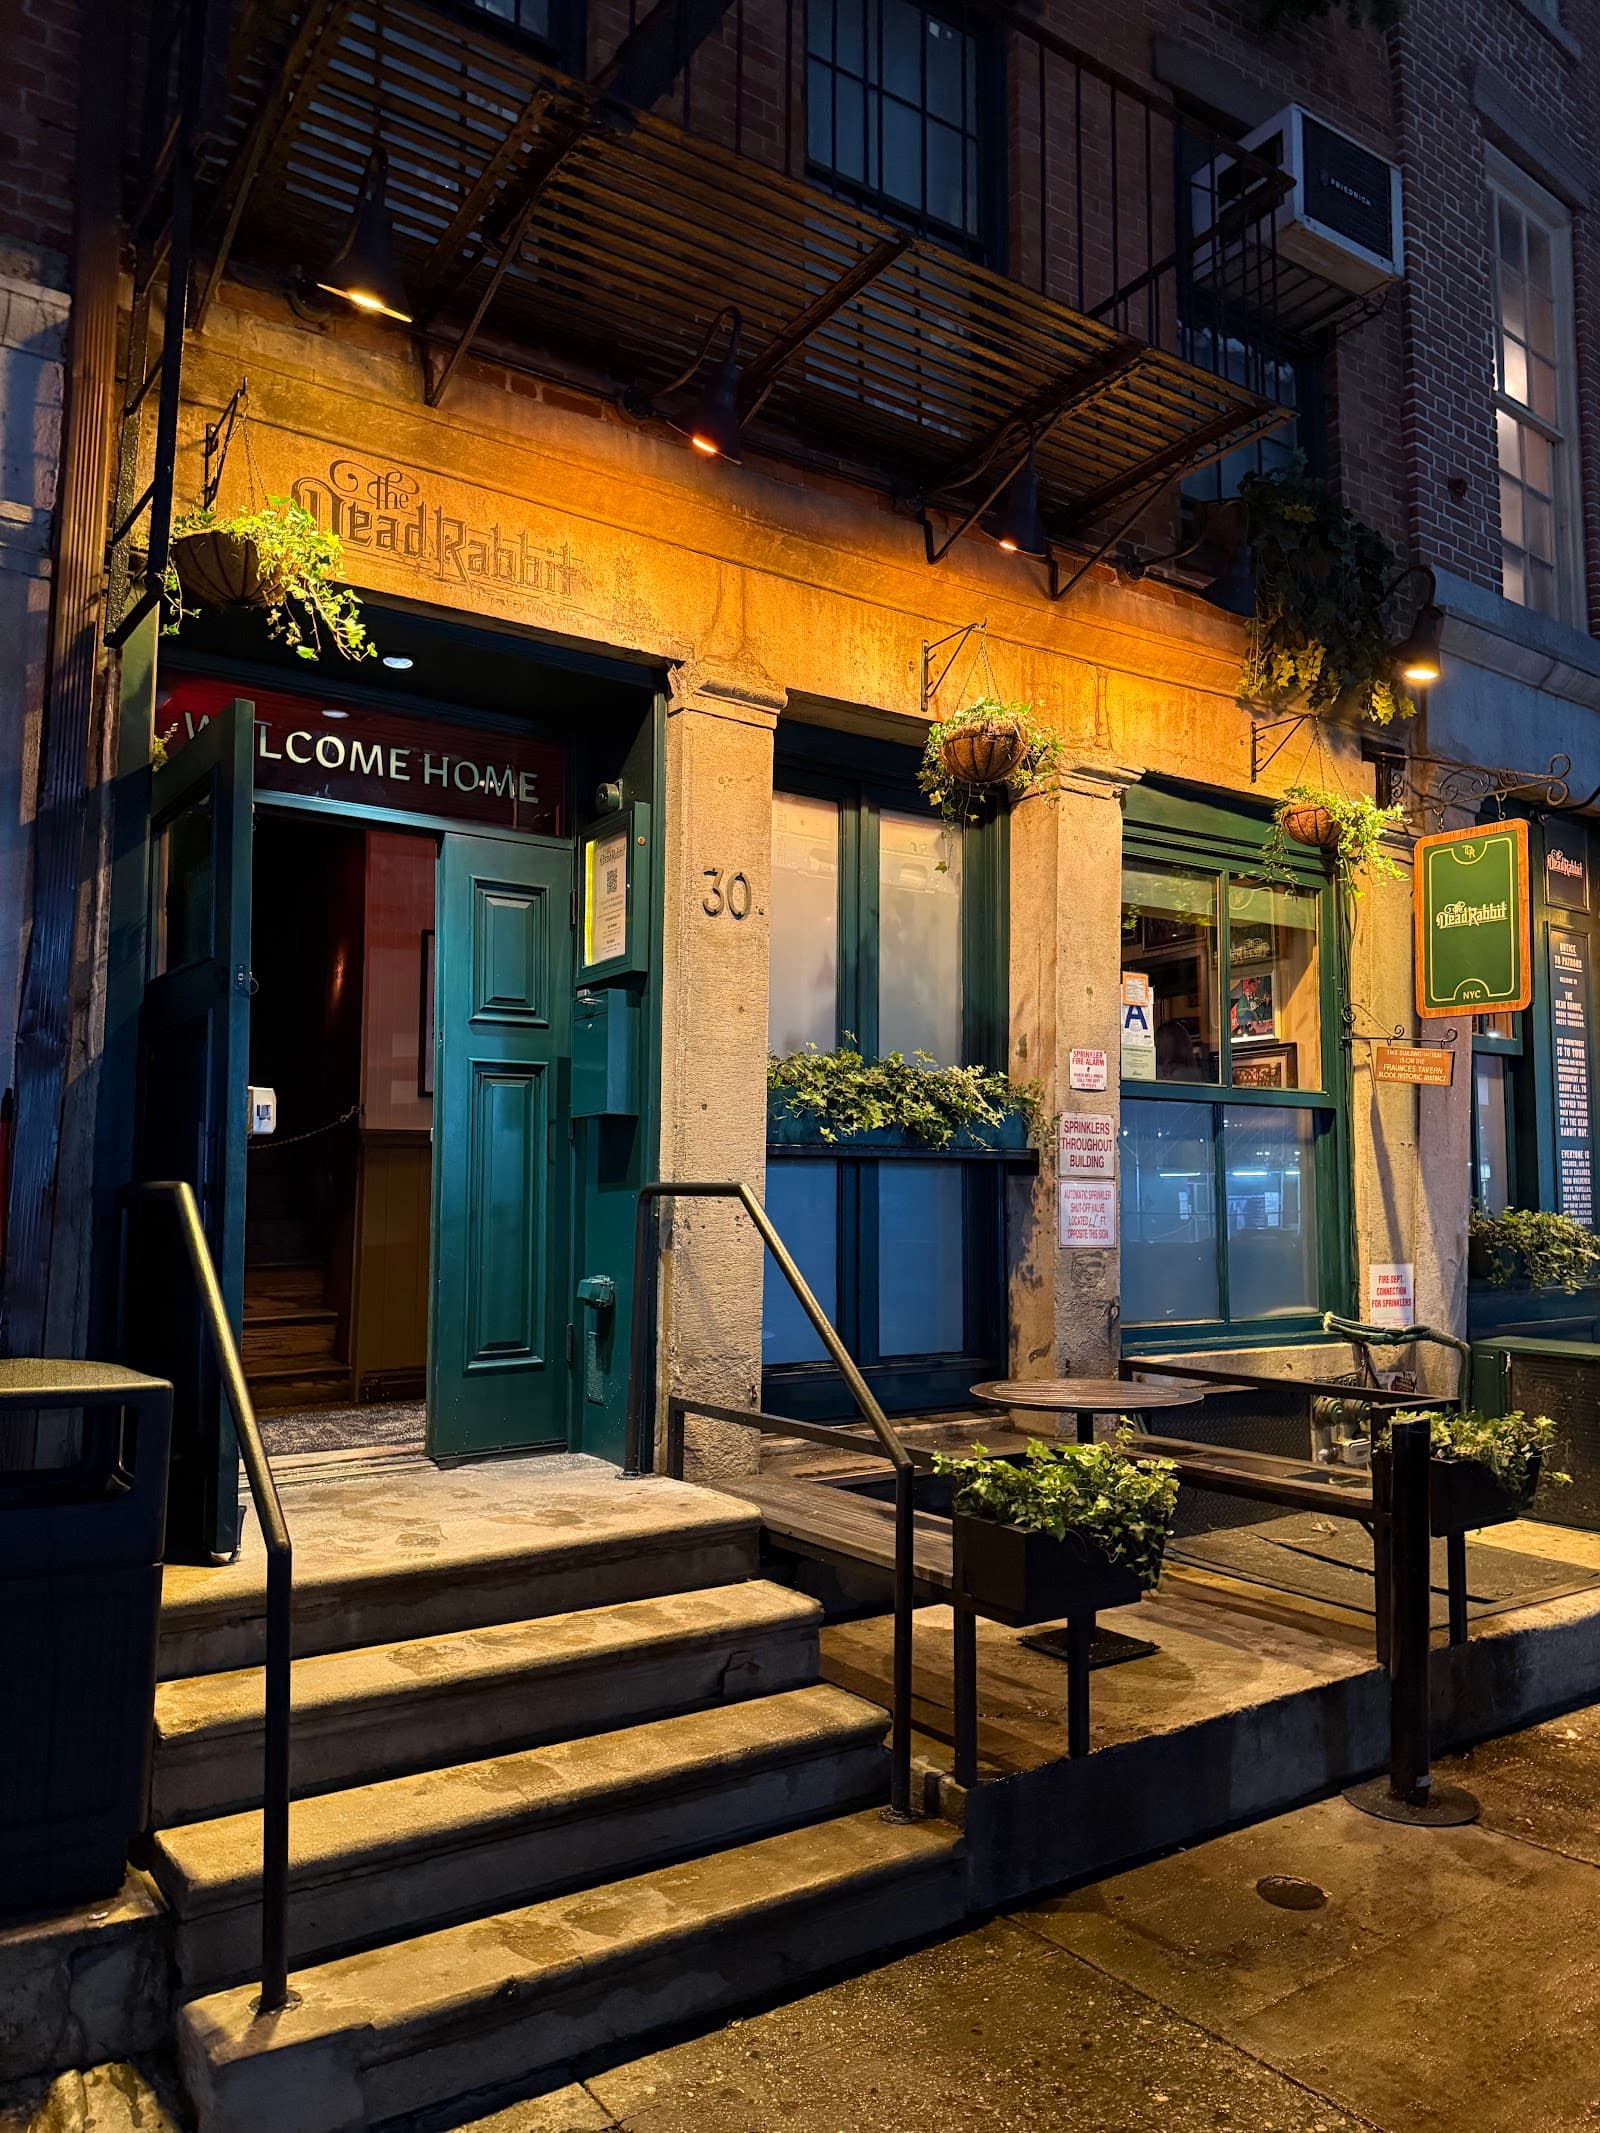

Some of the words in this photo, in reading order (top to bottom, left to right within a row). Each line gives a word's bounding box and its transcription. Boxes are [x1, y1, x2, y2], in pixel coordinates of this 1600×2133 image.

[330, 459, 419, 510] The
[291, 477, 427, 560] Dead
[433, 505, 578, 596] Rabbit
[185, 712, 411, 781] WLCOME
[423, 752, 539, 804] HOME
[702, 866, 752, 920] 30
[1444, 901, 1465, 914] The
[1436, 906, 1467, 929] Dead
[1468, 901, 1507, 927] Rabbit
[1463, 990, 1481, 999] NYC
[1124, 1005, 1149, 1030] A
[1073, 1050, 1103, 1058] SPRINKLER
[1564, 1046, 1570, 1057] TO
[1085, 1058, 1105, 1066] ALARM
[1383, 1063, 1416, 1073] FRAUNCES
[1418, 1065, 1443, 1075] TAVERN
[1379, 1071, 1397, 1079] BLOCK
[1397, 1072, 1424, 1080] HISTORIC
[1064, 1120, 1110, 1136] SPRINKLERS
[1062, 1137, 1113, 1152] THROUGHOUT
[1070, 1154, 1105, 1169] BUILDING
[1064, 1189, 1088, 1200] AUTOMATIC
[1088, 1190, 1111, 1200] SPRINKLER
[1071, 1202, 1091, 1213] SHUT-OFF
[1092, 1203, 1105, 1213] VALVE
[1068, 1215, 1089, 1226] LOCATED
[1067, 1228, 1089, 1239] OPPOSITE
[1089, 1229, 1098, 1239] THIS
[1098, 1229, 1109, 1239] SIGN
[1379, 1274, 1389, 1283] FIRE
[1376, 1286, 1407, 1296] CONNECTION
[1371, 1299, 1382, 1308] FOR
[1382, 1298, 1412, 1308] SPRINKLERS
